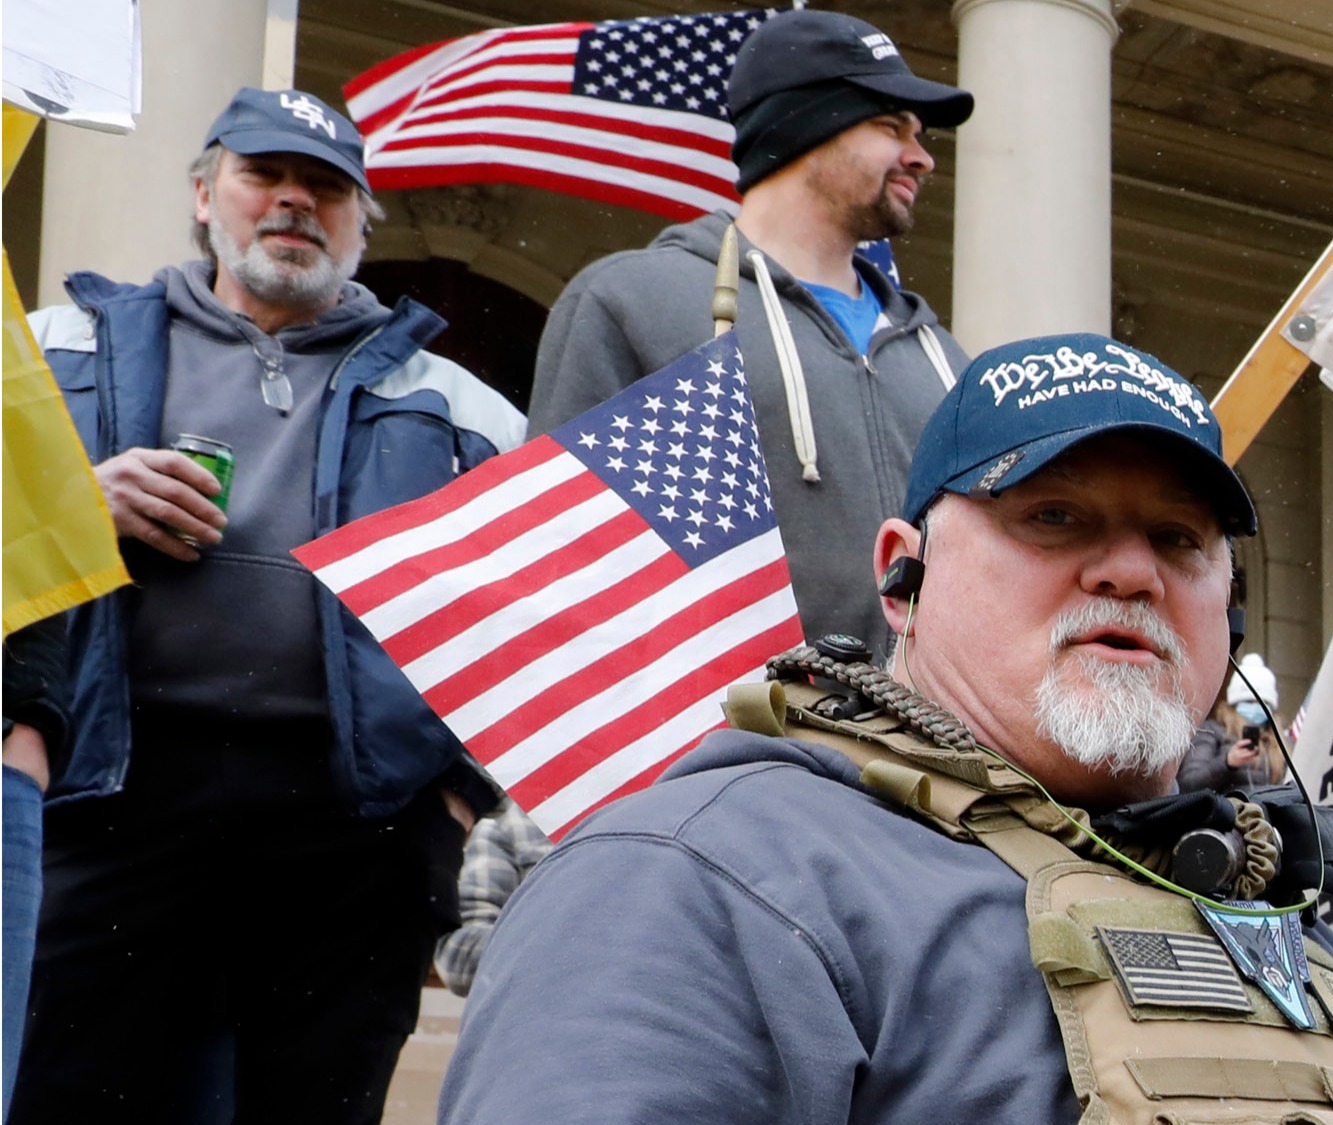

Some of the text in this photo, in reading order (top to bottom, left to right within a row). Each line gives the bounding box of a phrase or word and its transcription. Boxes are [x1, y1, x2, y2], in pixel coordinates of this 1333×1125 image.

[979, 360, 1050, 407] We
[1018, 378, 1192, 429] HAVE HAD ENOUGH
